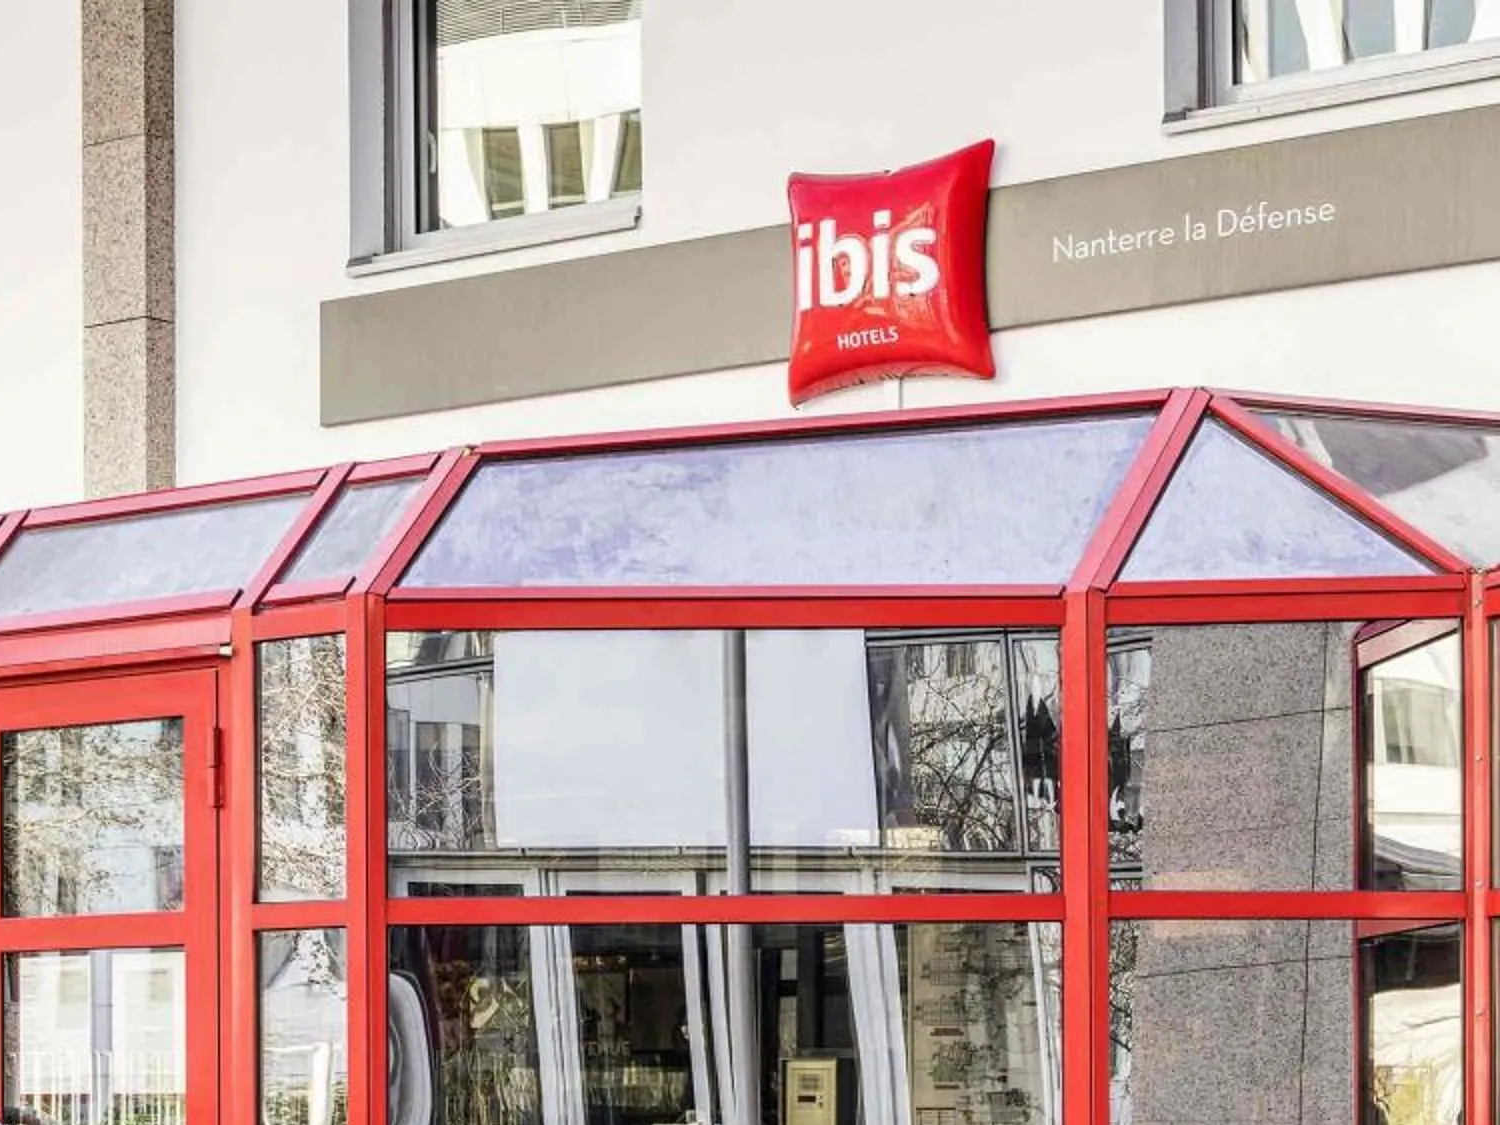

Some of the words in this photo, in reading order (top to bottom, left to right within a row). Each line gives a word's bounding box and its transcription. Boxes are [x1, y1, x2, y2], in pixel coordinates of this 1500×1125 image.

[797, 209, 940, 311] ibis
[1052, 227, 1174, 263] Nanterre
[1184, 212, 1207, 242] la
[1216, 202, 1336, 237] Défense
[837, 326, 899, 349] HOTELS
